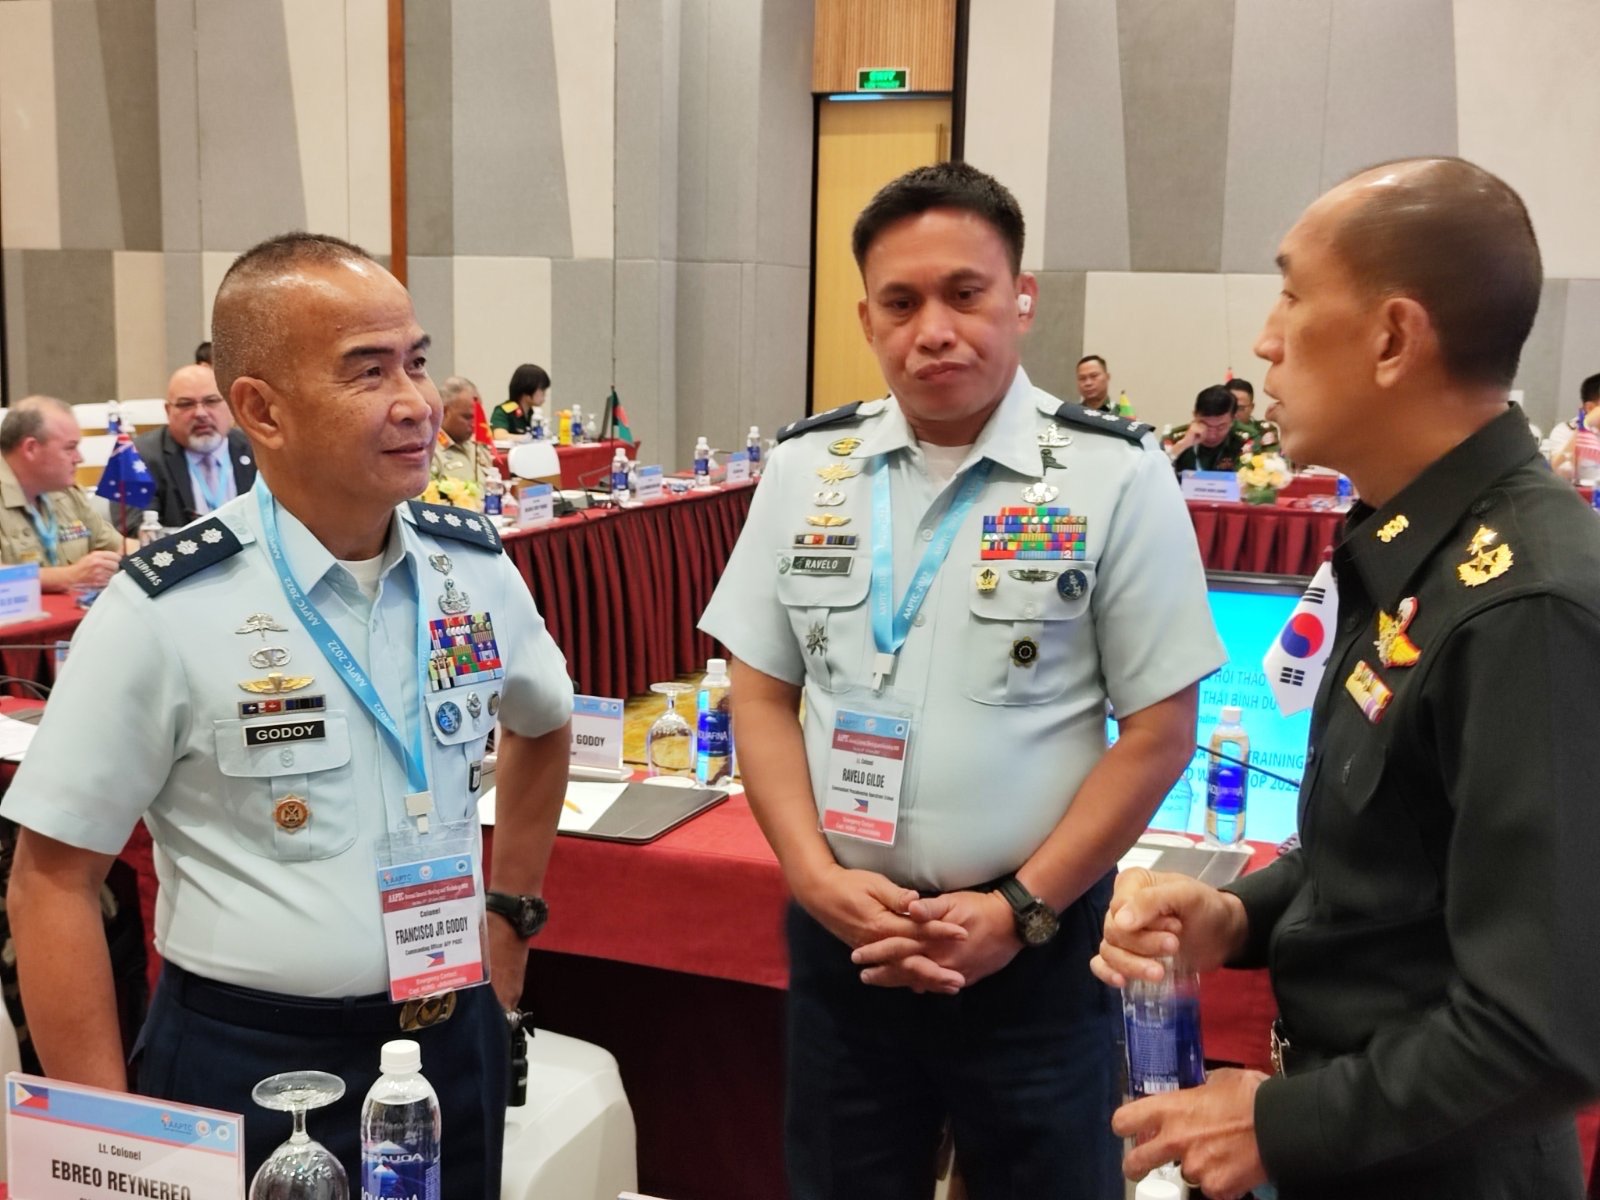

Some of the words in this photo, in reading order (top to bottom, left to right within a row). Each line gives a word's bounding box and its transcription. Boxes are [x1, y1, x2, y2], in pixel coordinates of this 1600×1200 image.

[129, 556, 163, 587] PILIPINAS
[804, 559, 839, 570] RAVELO
[284, 577, 300, 600] 2022
[297, 600, 320, 626] AAPTC
[327, 639, 348, 662] 2022
[343, 661, 368, 688] AAPTC
[256, 725, 315, 741] GODOY
[576, 734, 605, 748] GODOY
[842, 768, 865, 785] RAVELO
[866, 773, 885, 789] GILDE
[420, 908, 441, 918] Colonel
[395, 923, 434, 946] FRANCISCO
[436, 920, 445, 937] JR
[446, 916, 468, 935] GODOY
[98, 1143, 108, 1154] Lt.
[110, 1145, 142, 1161] Colonel
[52, 1159, 103, 1187] EBREO
[107, 1170, 191, 1200] REYNEREO
